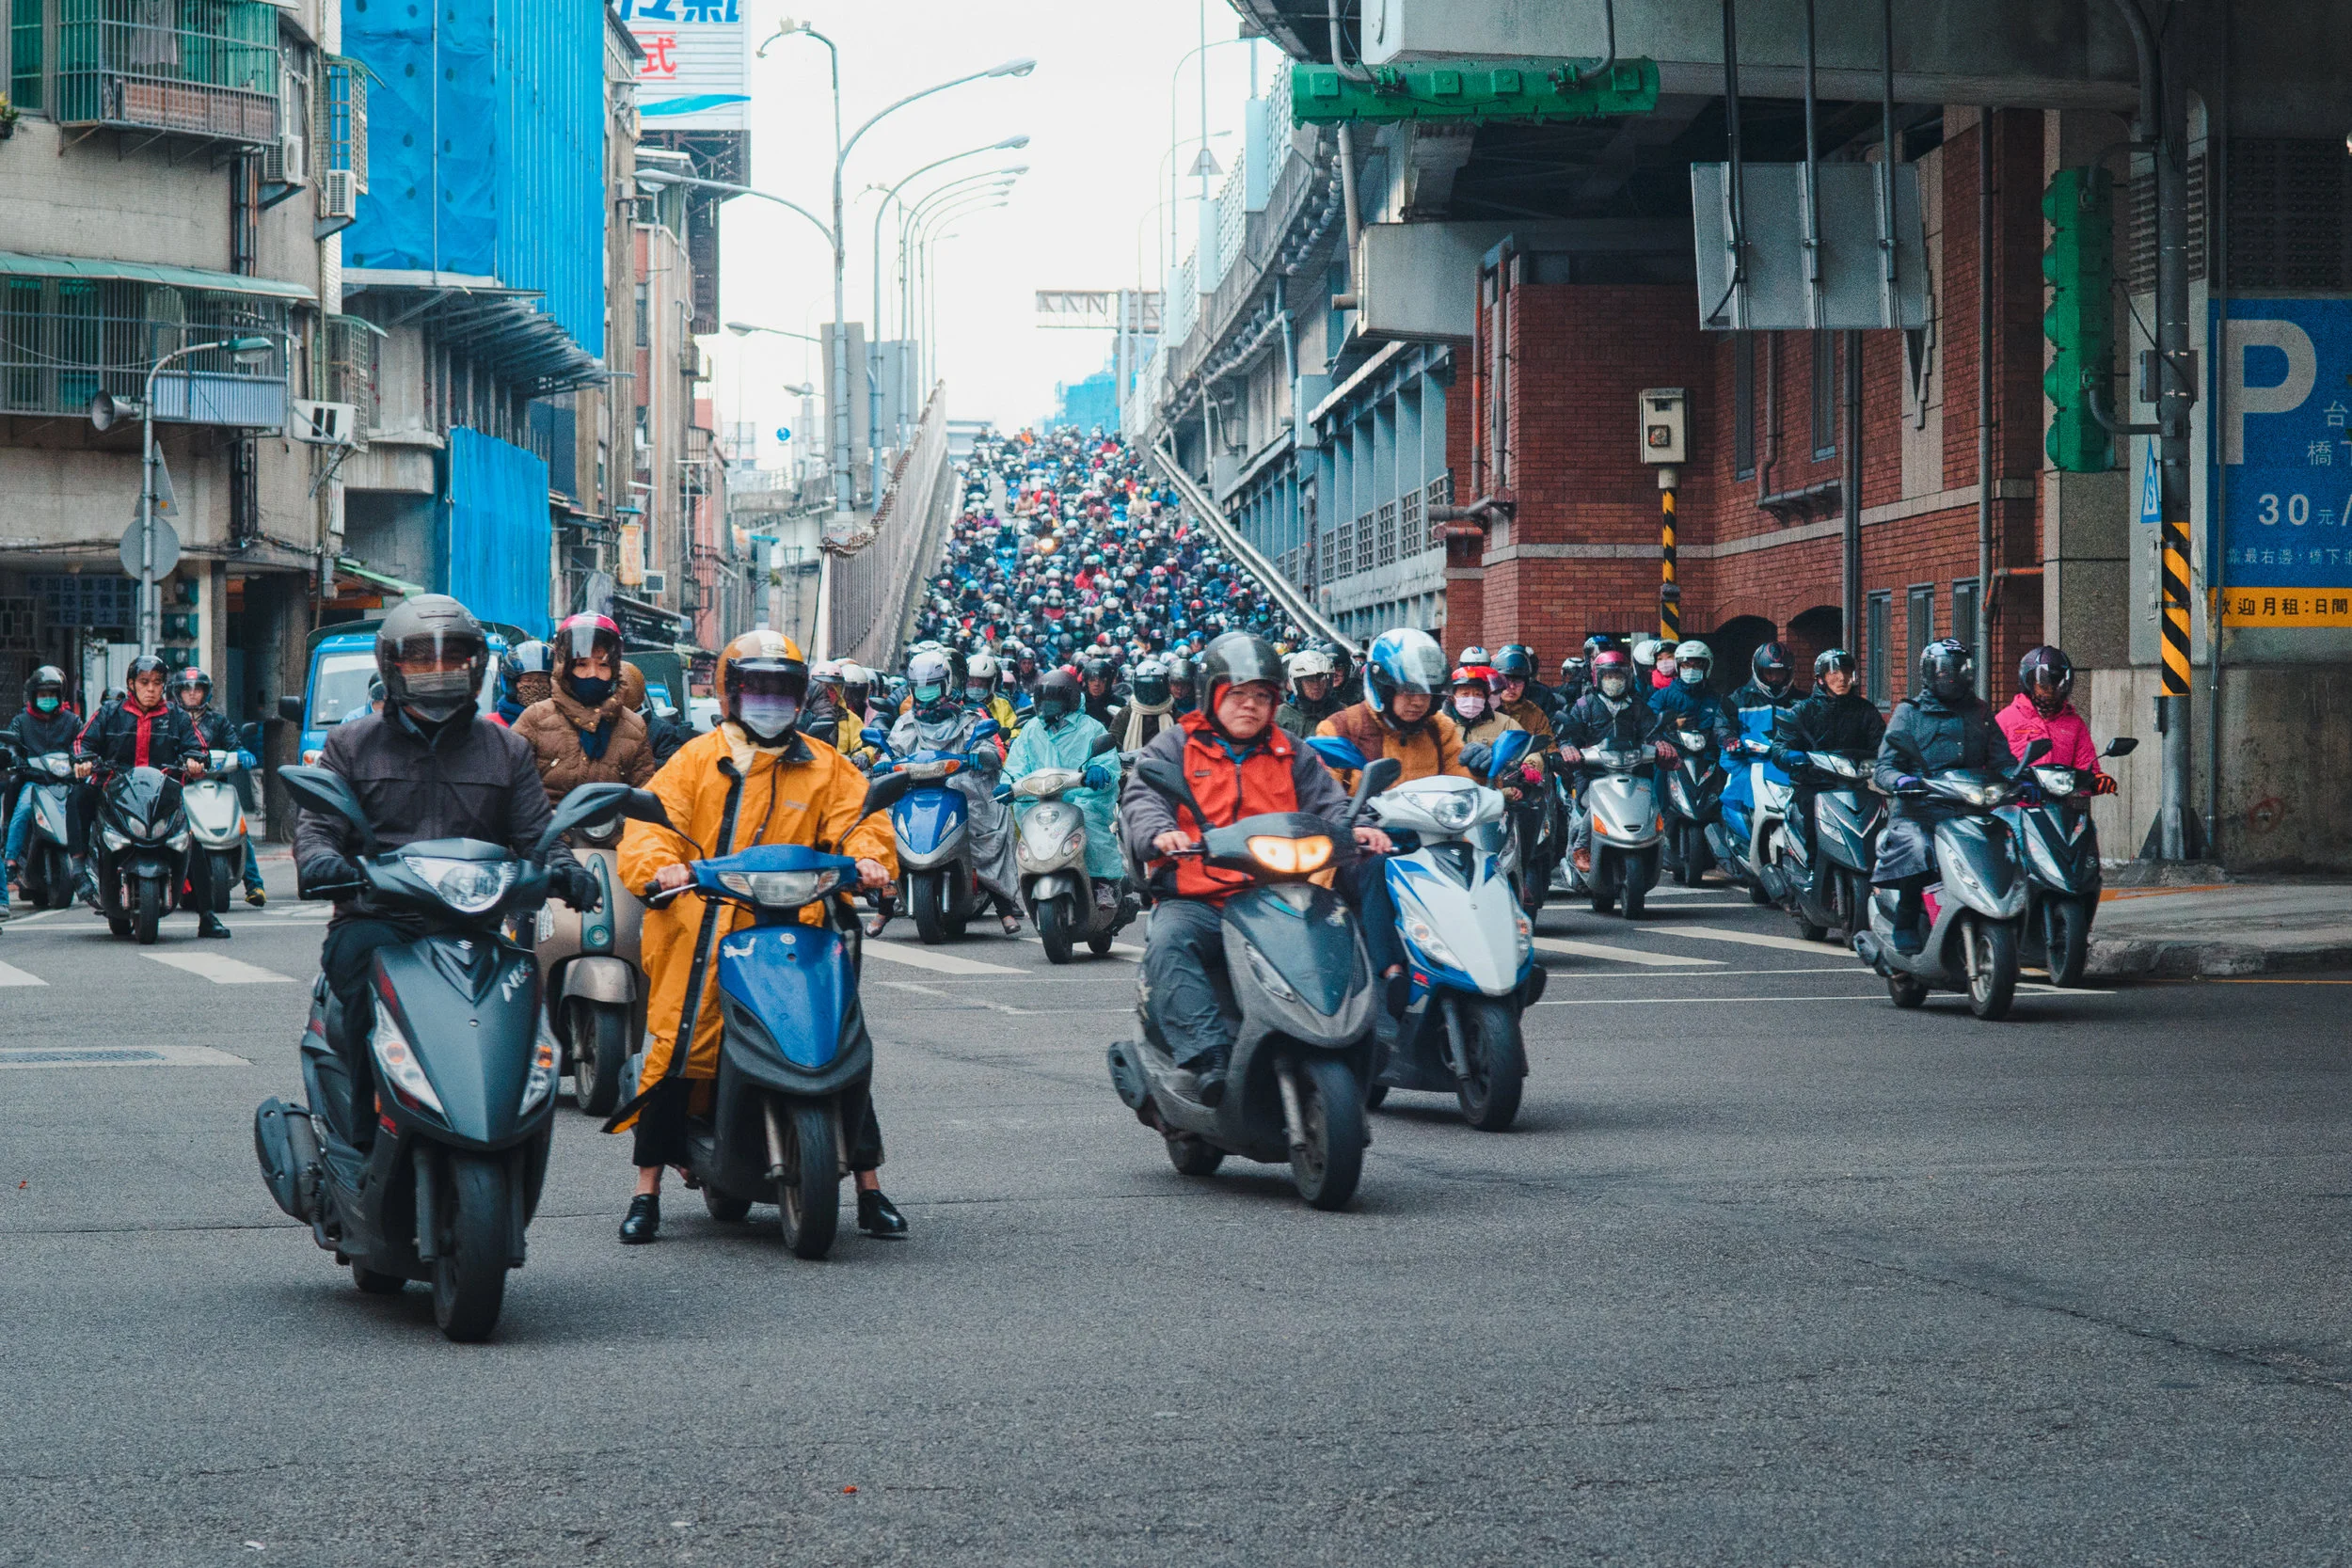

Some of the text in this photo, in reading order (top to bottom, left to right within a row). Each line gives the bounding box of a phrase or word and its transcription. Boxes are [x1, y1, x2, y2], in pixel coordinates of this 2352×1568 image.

[641, 37, 677, 73] 式
[2217, 320, 2316, 465] P
[2324, 401, 2348, 427] 台
